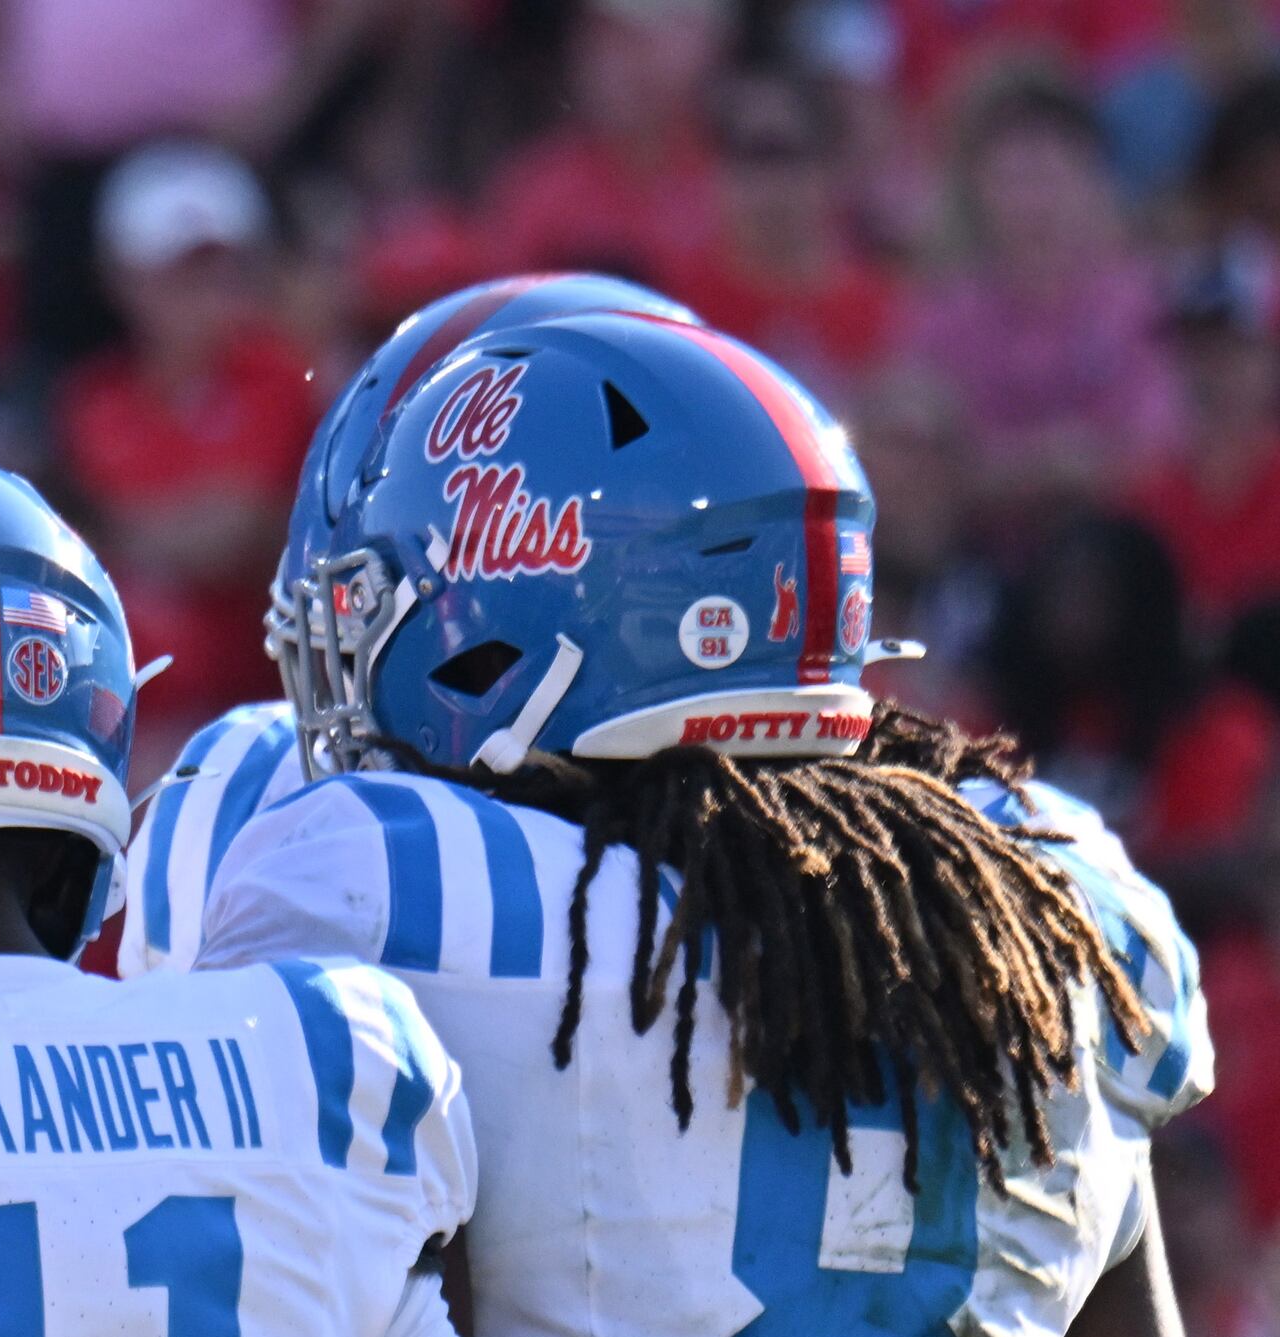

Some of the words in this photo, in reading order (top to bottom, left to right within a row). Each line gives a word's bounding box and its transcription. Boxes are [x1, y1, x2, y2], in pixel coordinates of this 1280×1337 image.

[424, 361, 530, 464] Ole
[442, 462, 591, 582] Miss
[698, 607, 734, 628] CA
[700, 637, 731, 658] 91
[11, 640, 64, 700] SEC
[681, 712, 810, 745] HOTTY
[209, 1038, 262, 1149] II
